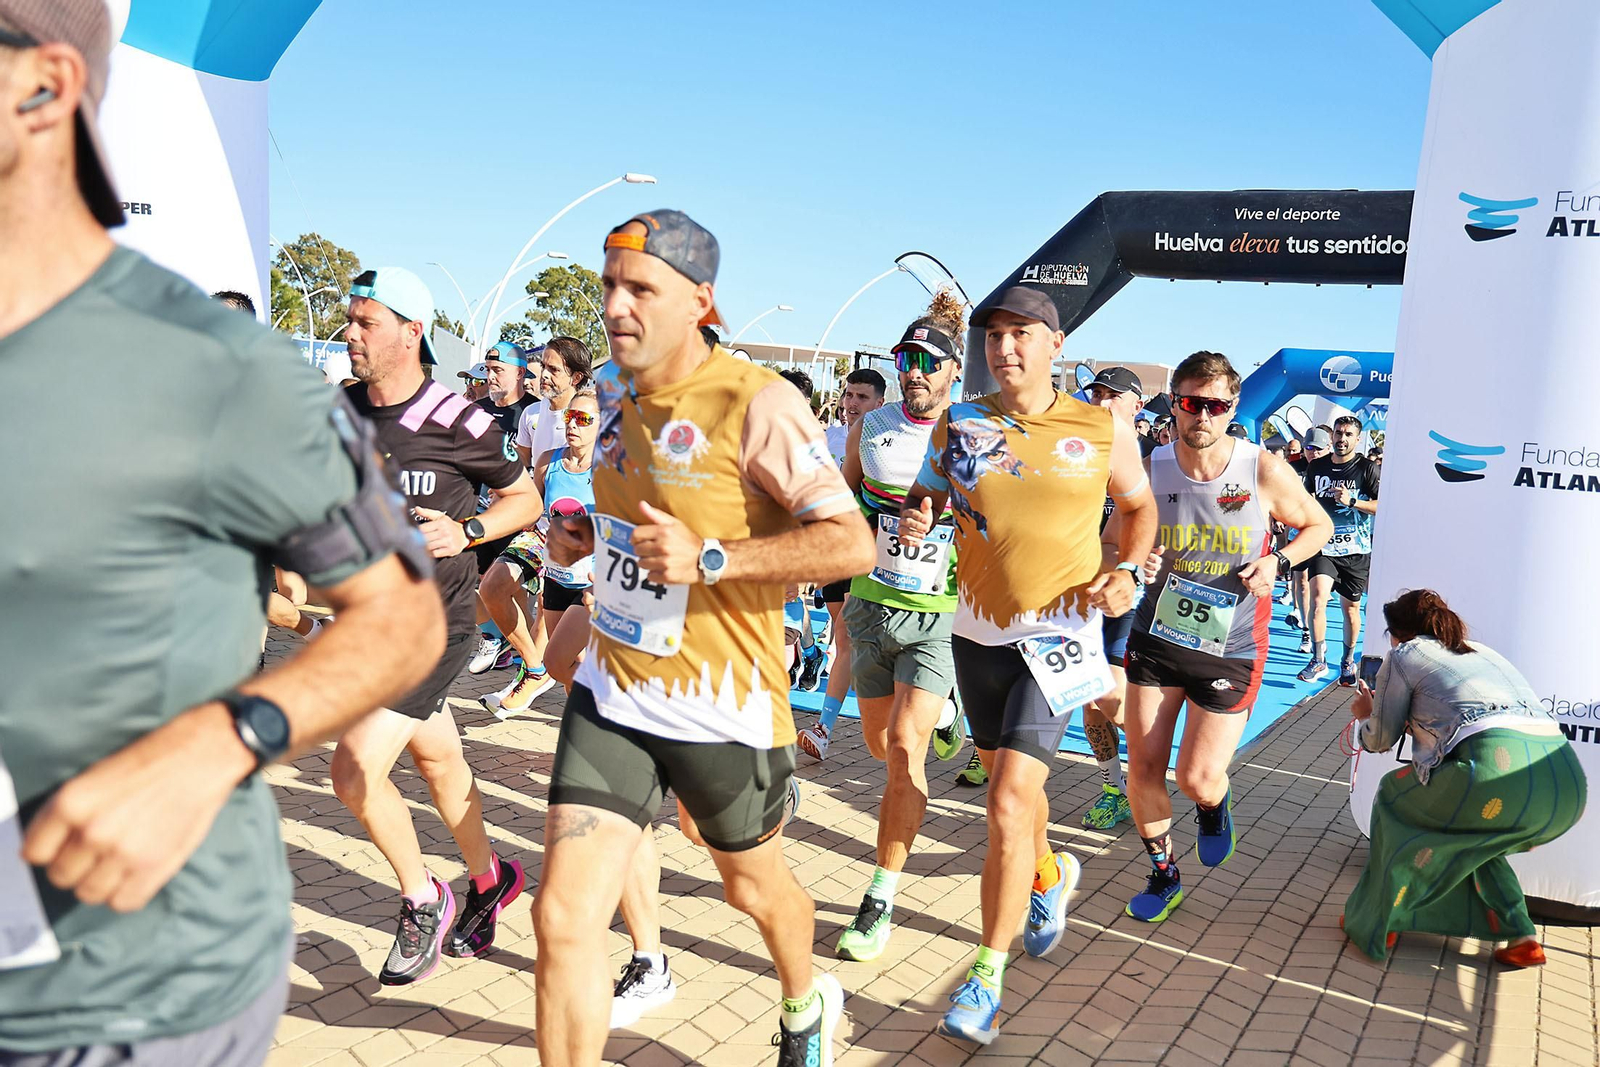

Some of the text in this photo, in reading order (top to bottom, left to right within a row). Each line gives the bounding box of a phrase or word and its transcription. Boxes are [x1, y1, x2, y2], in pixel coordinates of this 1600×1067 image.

[1233, 207, 1341, 224] Vive el deporte
[1154, 232, 1224, 252] Huelva
[1229, 232, 1280, 253] eleva
[1286, 237, 1319, 254] tus
[1040, 262, 1089, 273] DIPUTACIÓN
[1053, 272, 1088, 280] HUELVA
[1160, 523, 1253, 555] DOGFACE
[886, 535, 939, 564] 302
[1172, 558, 1231, 576] since 2014
[883, 570, 918, 587] Wayalia
[1176, 597, 1212, 623] 95
[1162, 624, 1197, 644] Wayalia
[1045, 640, 1084, 674] 99
